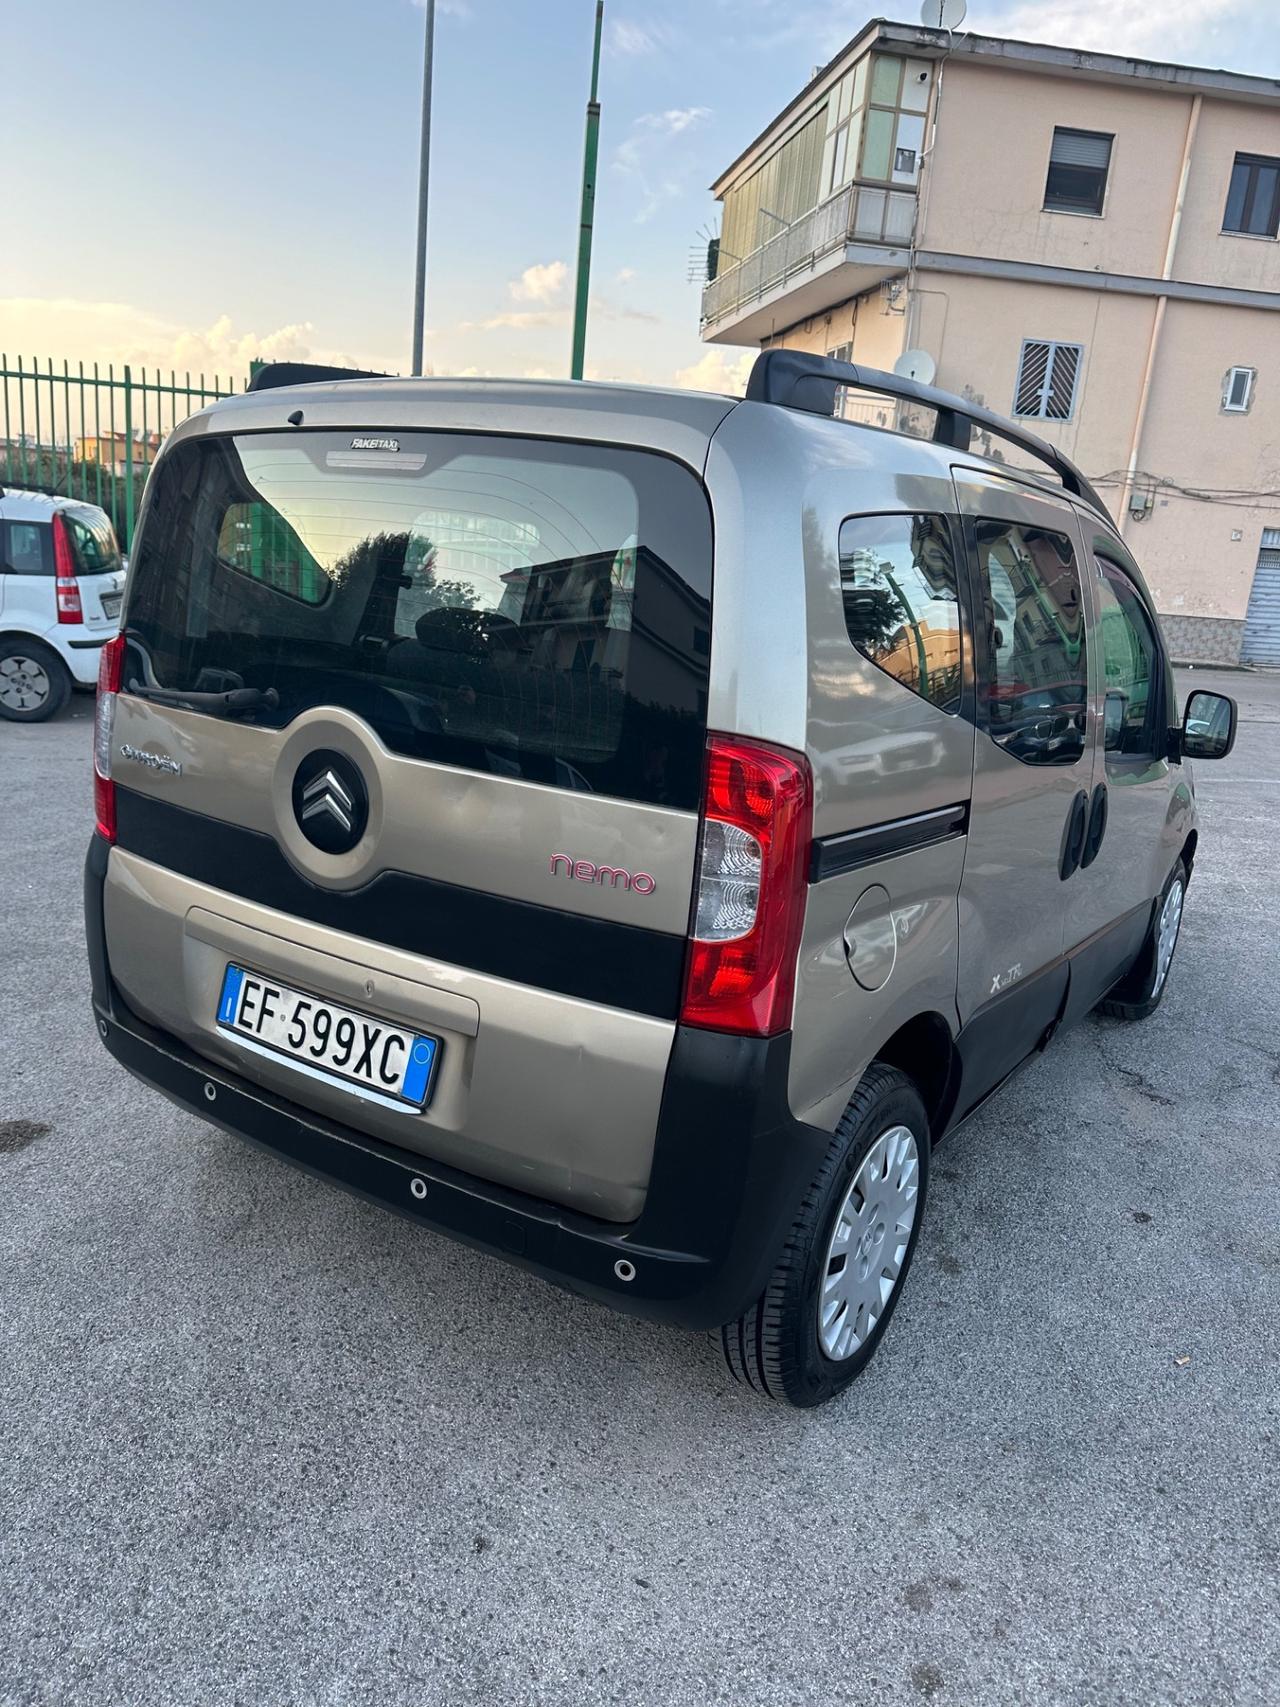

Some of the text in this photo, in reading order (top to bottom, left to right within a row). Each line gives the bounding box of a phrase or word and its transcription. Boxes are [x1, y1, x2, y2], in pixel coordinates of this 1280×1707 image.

[549, 853, 656, 895] nemo
[238, 979, 405, 1085] EF 599XC
